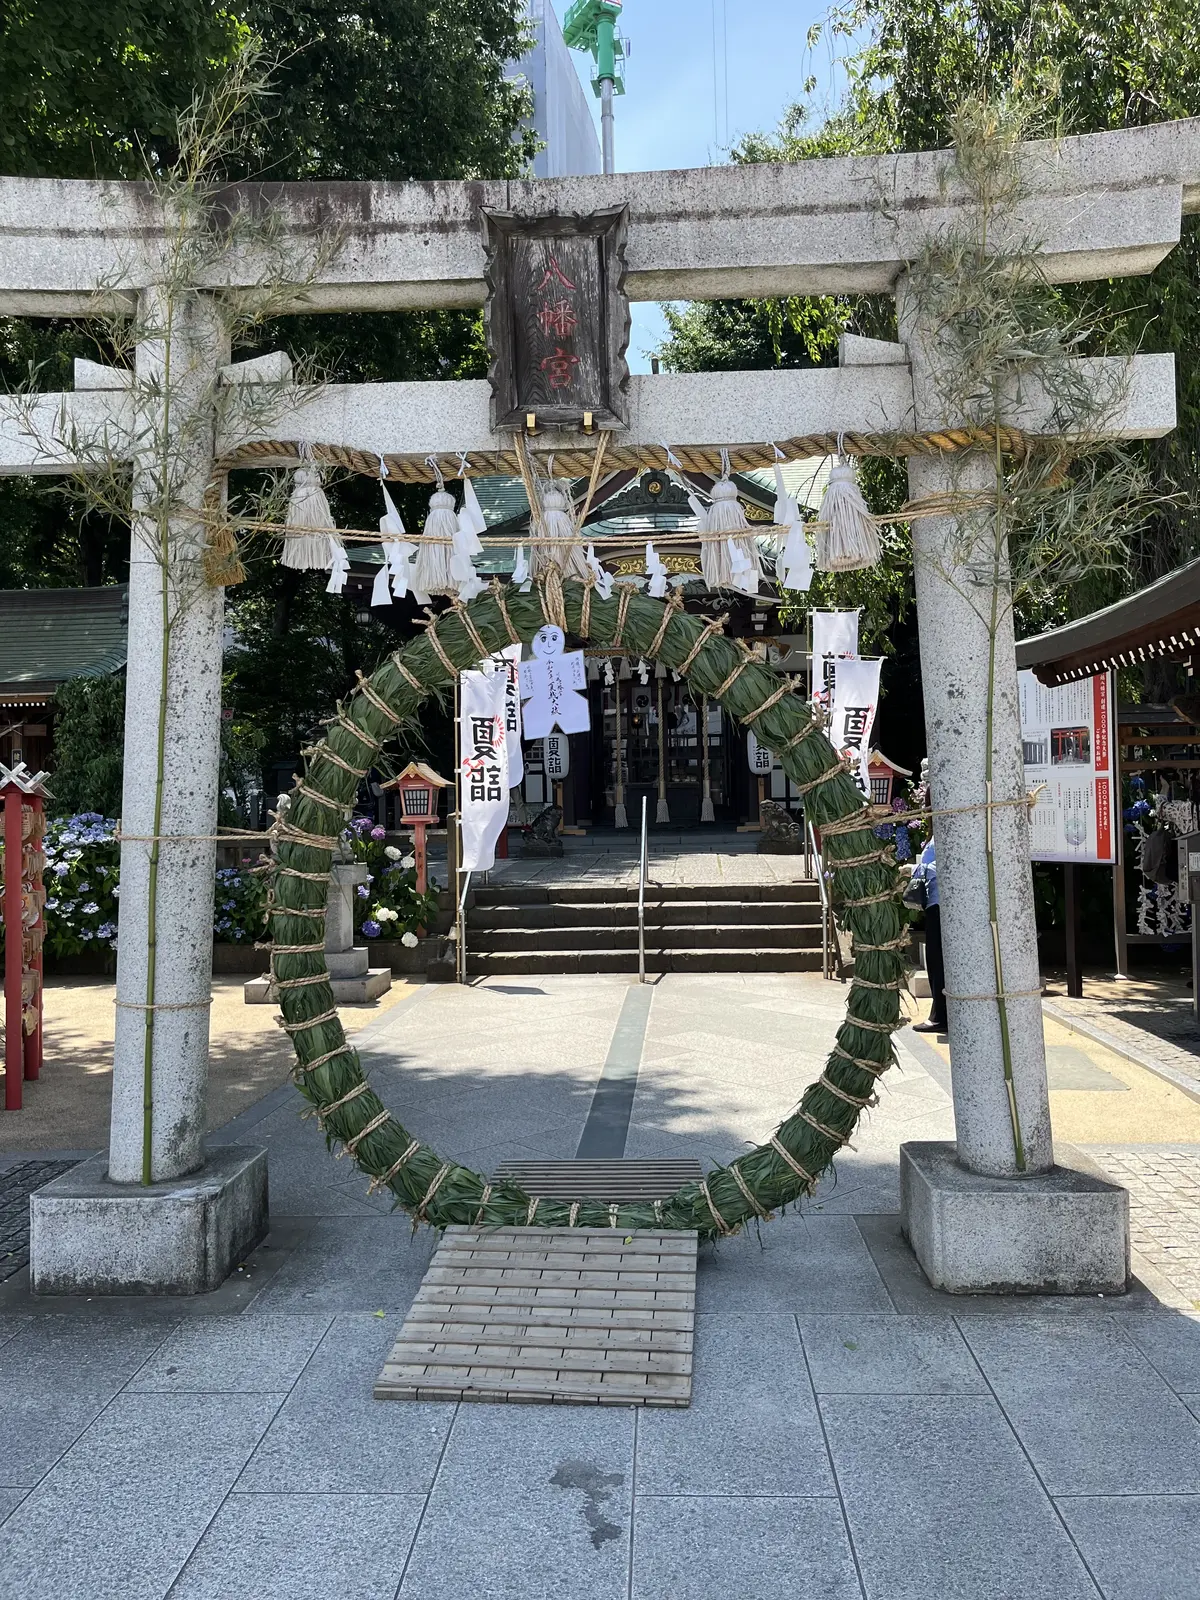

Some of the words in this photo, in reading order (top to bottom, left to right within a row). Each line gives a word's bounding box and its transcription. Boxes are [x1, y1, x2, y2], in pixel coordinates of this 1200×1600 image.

[537, 256, 580, 389] 八幡宮
[548, 737, 561, 773] 夏詣
